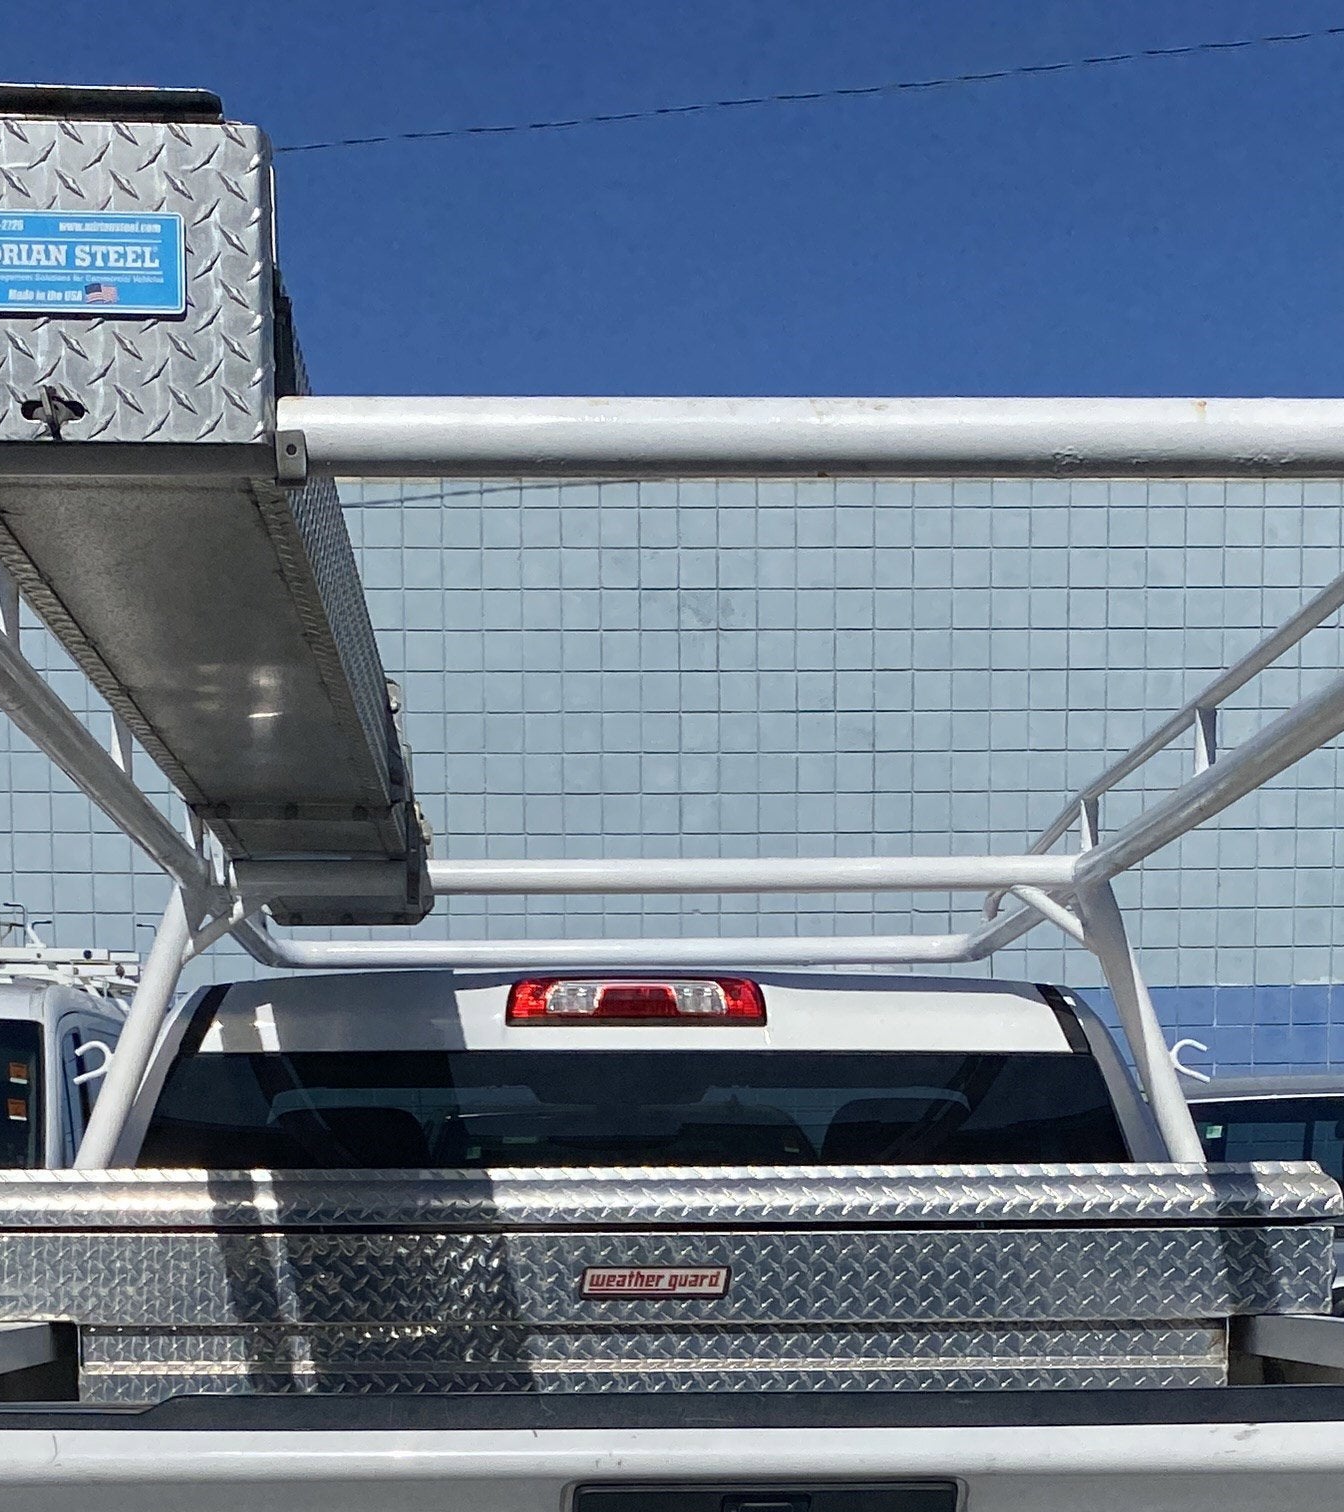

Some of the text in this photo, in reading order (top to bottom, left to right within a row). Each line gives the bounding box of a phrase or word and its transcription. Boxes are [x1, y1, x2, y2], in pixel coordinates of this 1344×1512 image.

[74, 245, 160, 268] STEEL
[64, 290, 83, 301] USA
[589, 1271, 720, 1291] weather guard
